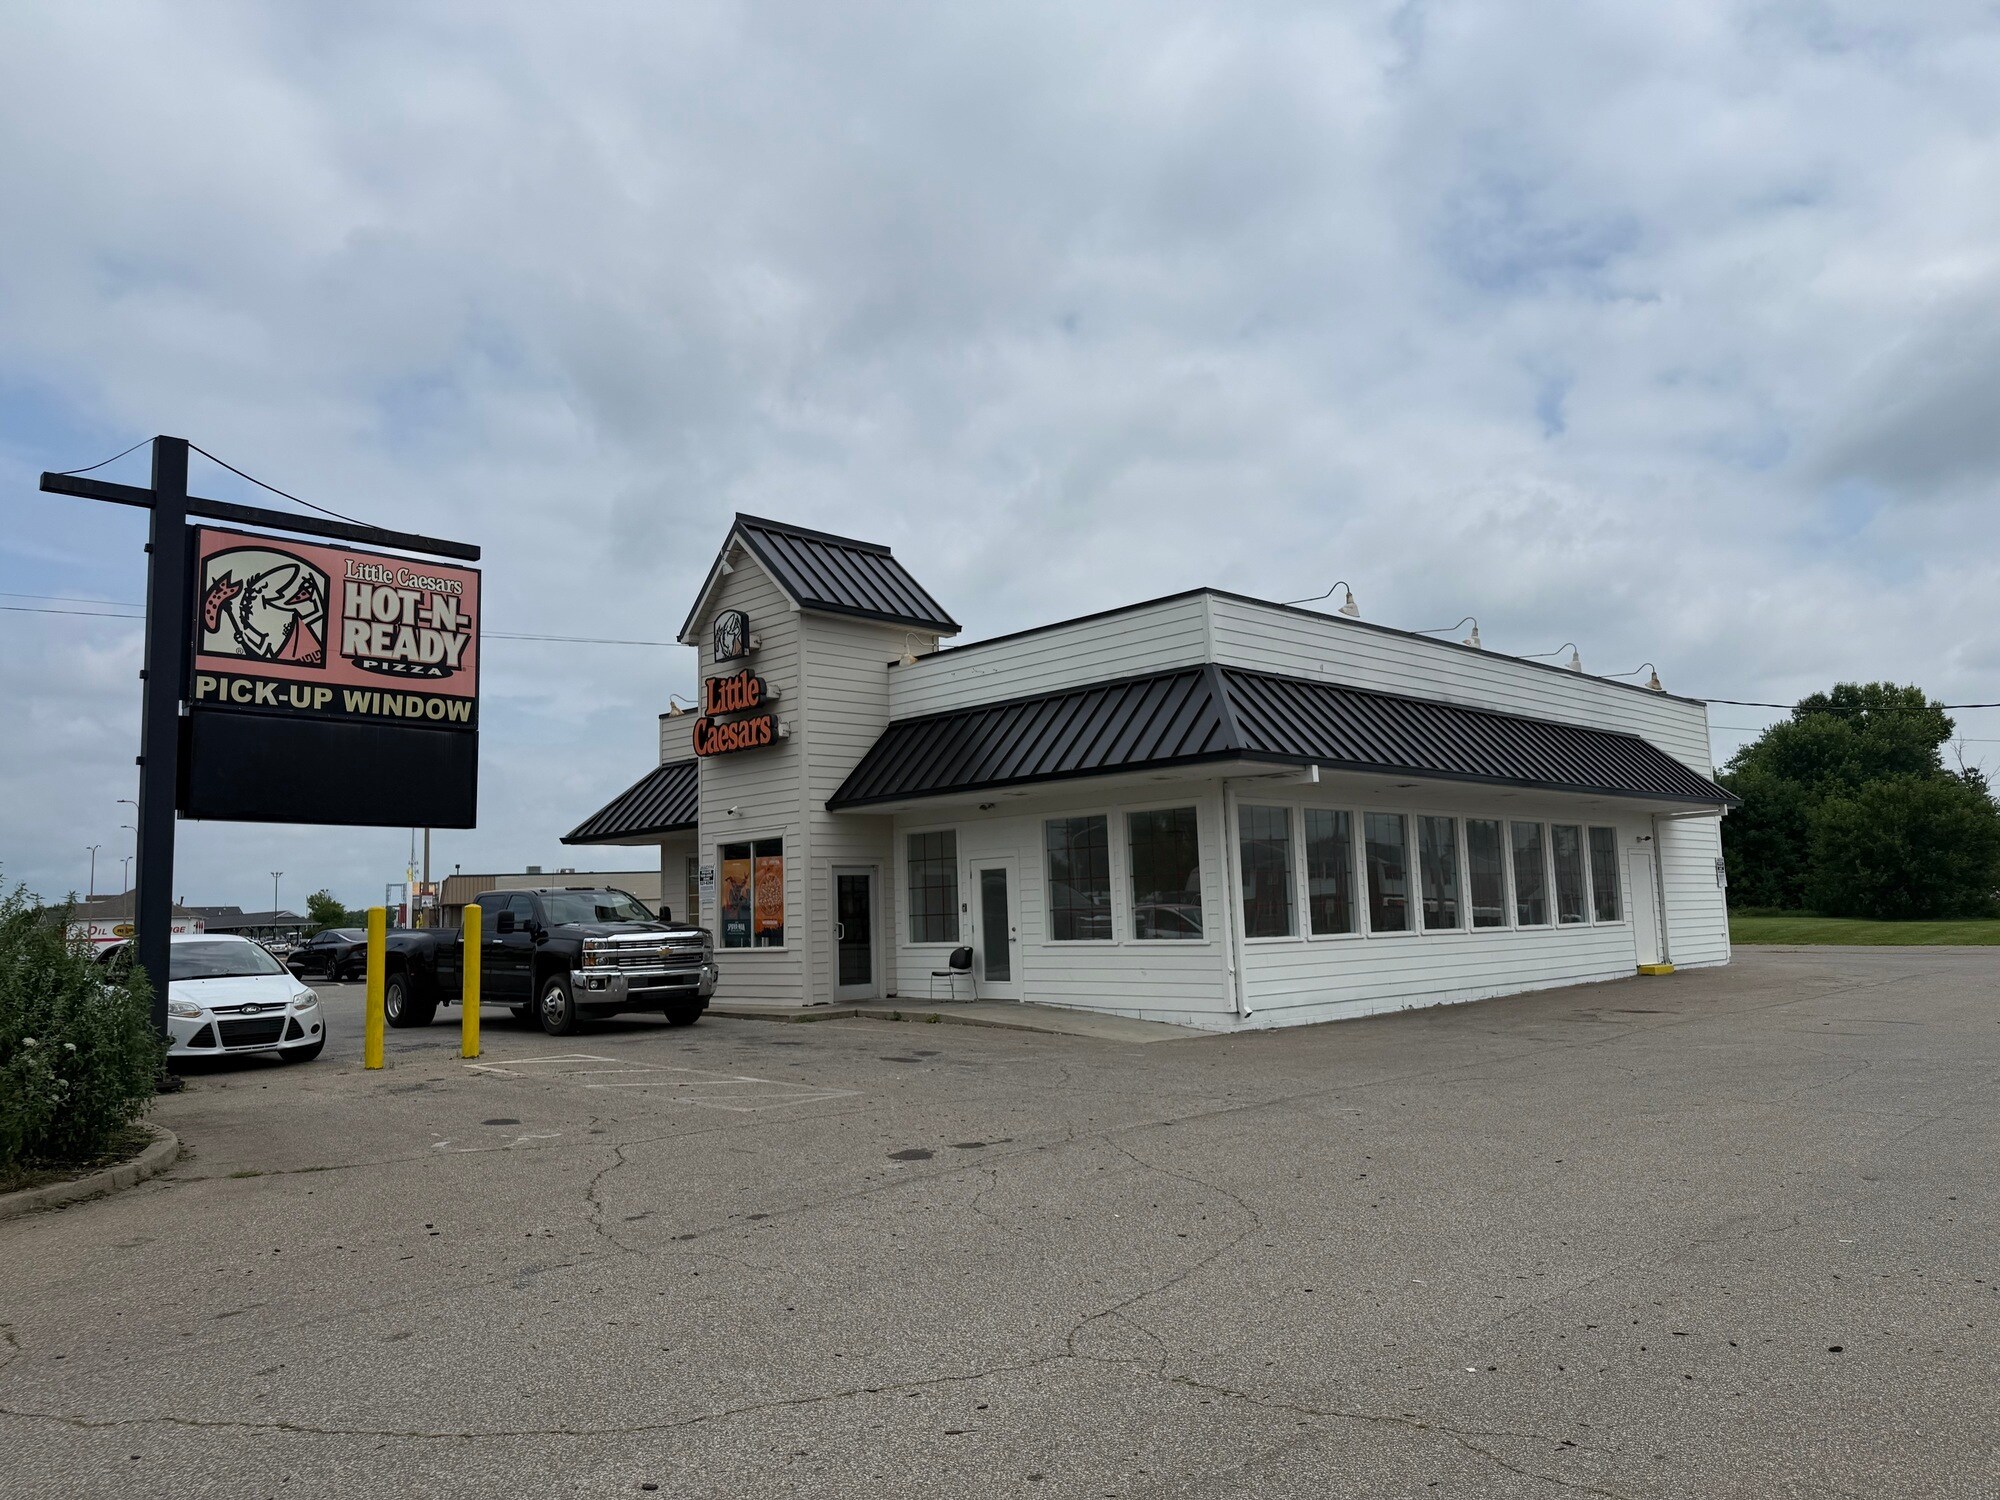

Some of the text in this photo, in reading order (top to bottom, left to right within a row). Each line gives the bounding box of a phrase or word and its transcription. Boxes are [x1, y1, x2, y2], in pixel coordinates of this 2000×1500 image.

[344, 559, 463, 595] Little Caesars
[341, 618, 469, 668] READY
[362, 660, 443, 677] PIZZA
[195, 675, 471, 722] PICK-UP WINDOW
[705, 670, 760, 716] Little
[693, 715, 772, 757] Caesars
